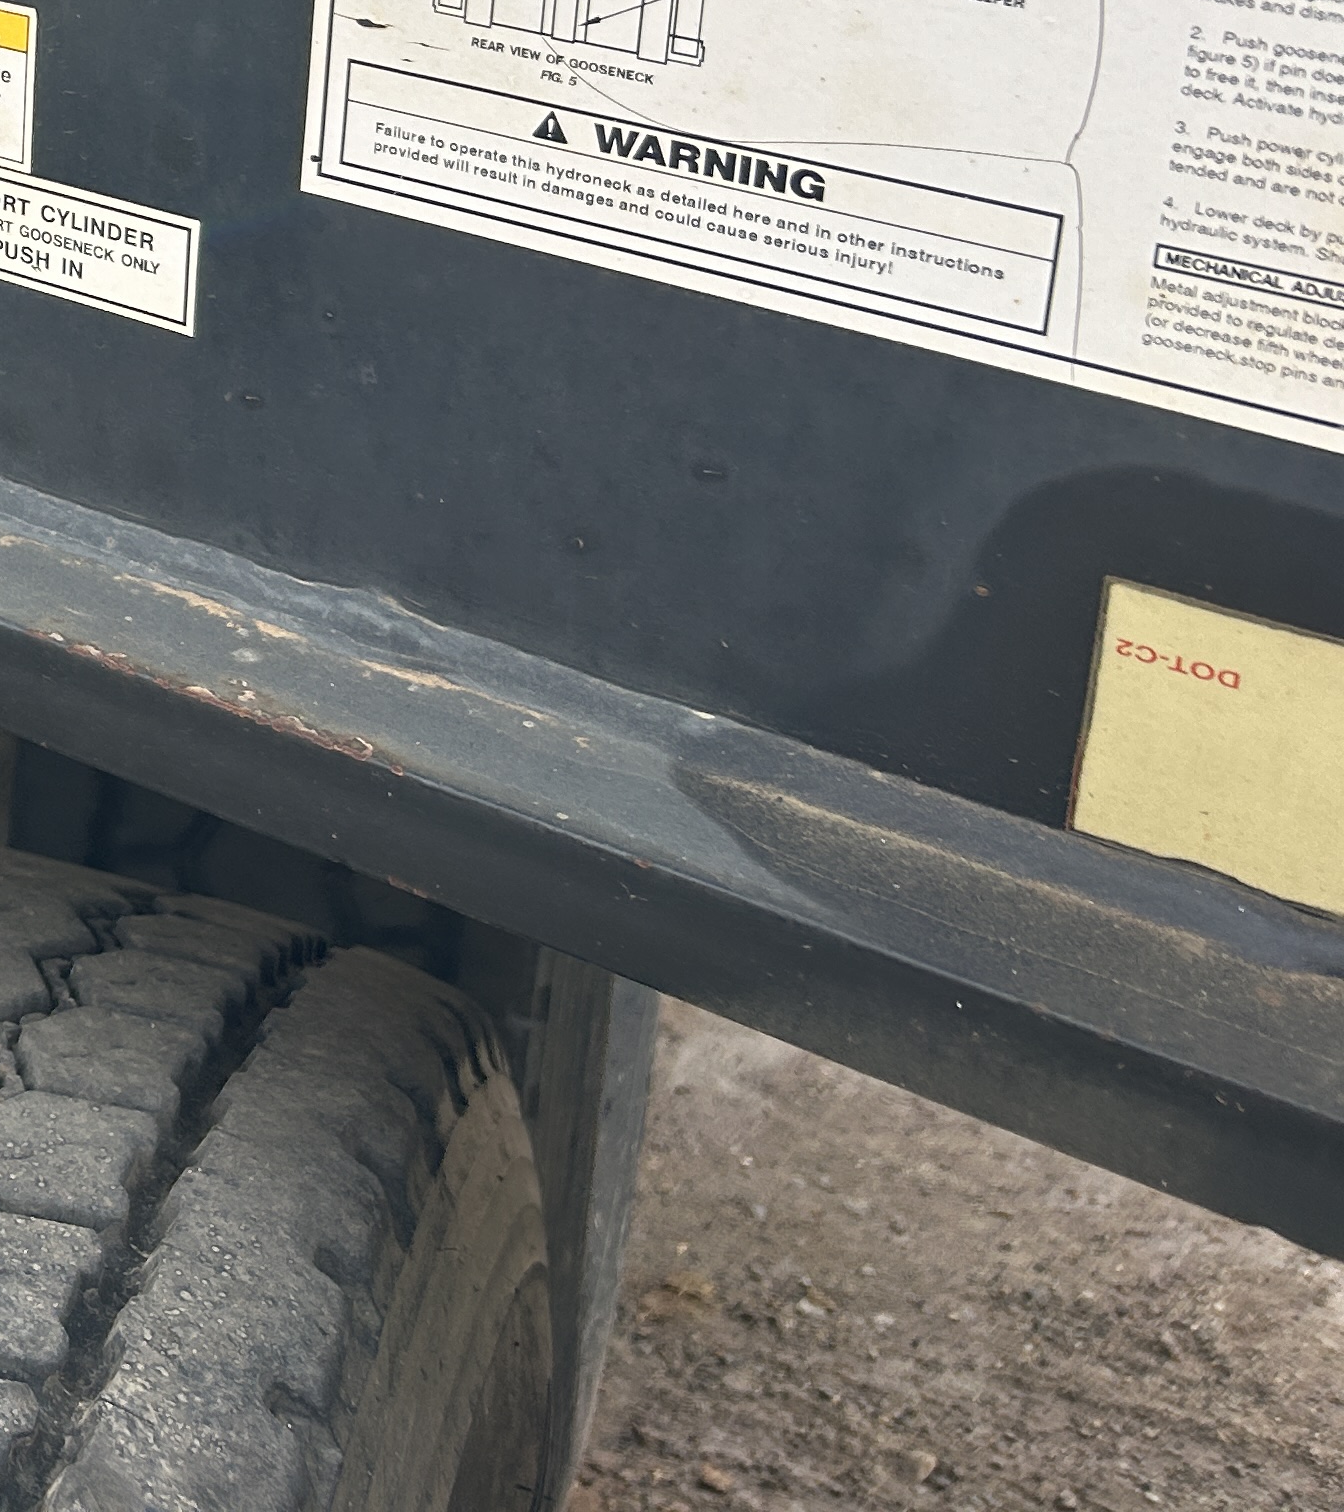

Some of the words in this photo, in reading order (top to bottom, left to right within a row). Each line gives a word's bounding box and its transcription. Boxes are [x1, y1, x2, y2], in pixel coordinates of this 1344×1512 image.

[1260, 1, 1296, 15] and
[471, 37, 504, 53] REAR
[509, 45, 541, 61] VIEW
[546, 53, 564, 66] OF
[569, 58, 654, 86] GOOSENECK
[1222, 30, 1268, 52] Push
[568, 76, 577, 86] 5
[1279, 63, 1307, 78] pin
[1232, 92, 1304, 118] Activate
[594, 122, 826, 203] WARNING
[1171, 142, 1237, 165] engage
[1242, 152, 1281, 173] both
[1285, 164, 1333, 184] sides
[1206, 126, 1252, 147] Push
[1256, 139, 1313, 160] power
[375, 121, 426, 145] Failure
[430, 134, 445, 149] to
[450, 140, 507, 164] operate
[512, 155, 541, 172] this
[546, 162, 632, 194] hydroneck
[636, 184, 655, 199] as
[661, 189, 727, 216] detailed
[733, 206, 771, 226] here
[776, 216, 810, 236] and
[816, 225, 832, 240] in
[837, 231, 885, 253] other
[890, 241, 1005, 281] instructions
[1168, 159, 1229, 182] tended
[1232, 174, 1267, 190] and
[1270, 182, 1301, 197] are
[1305, 188, 1335, 205] not
[41, 205, 154, 251] CYLINDER
[373, 141, 439, 167] provided
[443, 157, 469, 174] will
[473, 164, 518, 186] result
[522, 174, 536, 189] in
[541, 179, 614, 210] damages
[618, 199, 649, 216] and
[654, 207, 701, 229] could
[706, 219, 758, 243] cause
[763, 233, 829, 259] serious
[835, 248, 894, 277] injury!
[1159, 212, 1238, 242] hydraulic
[1194, 200, 1249, 224] Lower
[1252, 214, 1295, 235] deck
[1299, 223, 1323, 243] by
[19, 225, 115, 263] GOOSENECK
[121, 253, 161, 275] ONLY
[62, 257, 83, 280] IN
[1165, 251, 1284, 290] MECHANICAL
[1150, 275, 1198, 298] Metal
[1202, 290, 1299, 322] adjustment
[1147, 296, 1222, 323] provided
[1226, 313, 1243, 327] to
[1246, 319, 1319, 345] regulate
[1173, 319, 1252, 349] decrease
[1240, 355, 1277, 375] stop
[1280, 364, 1318, 384] pins
[1115, 638, 1241, 690] DOT-C2
